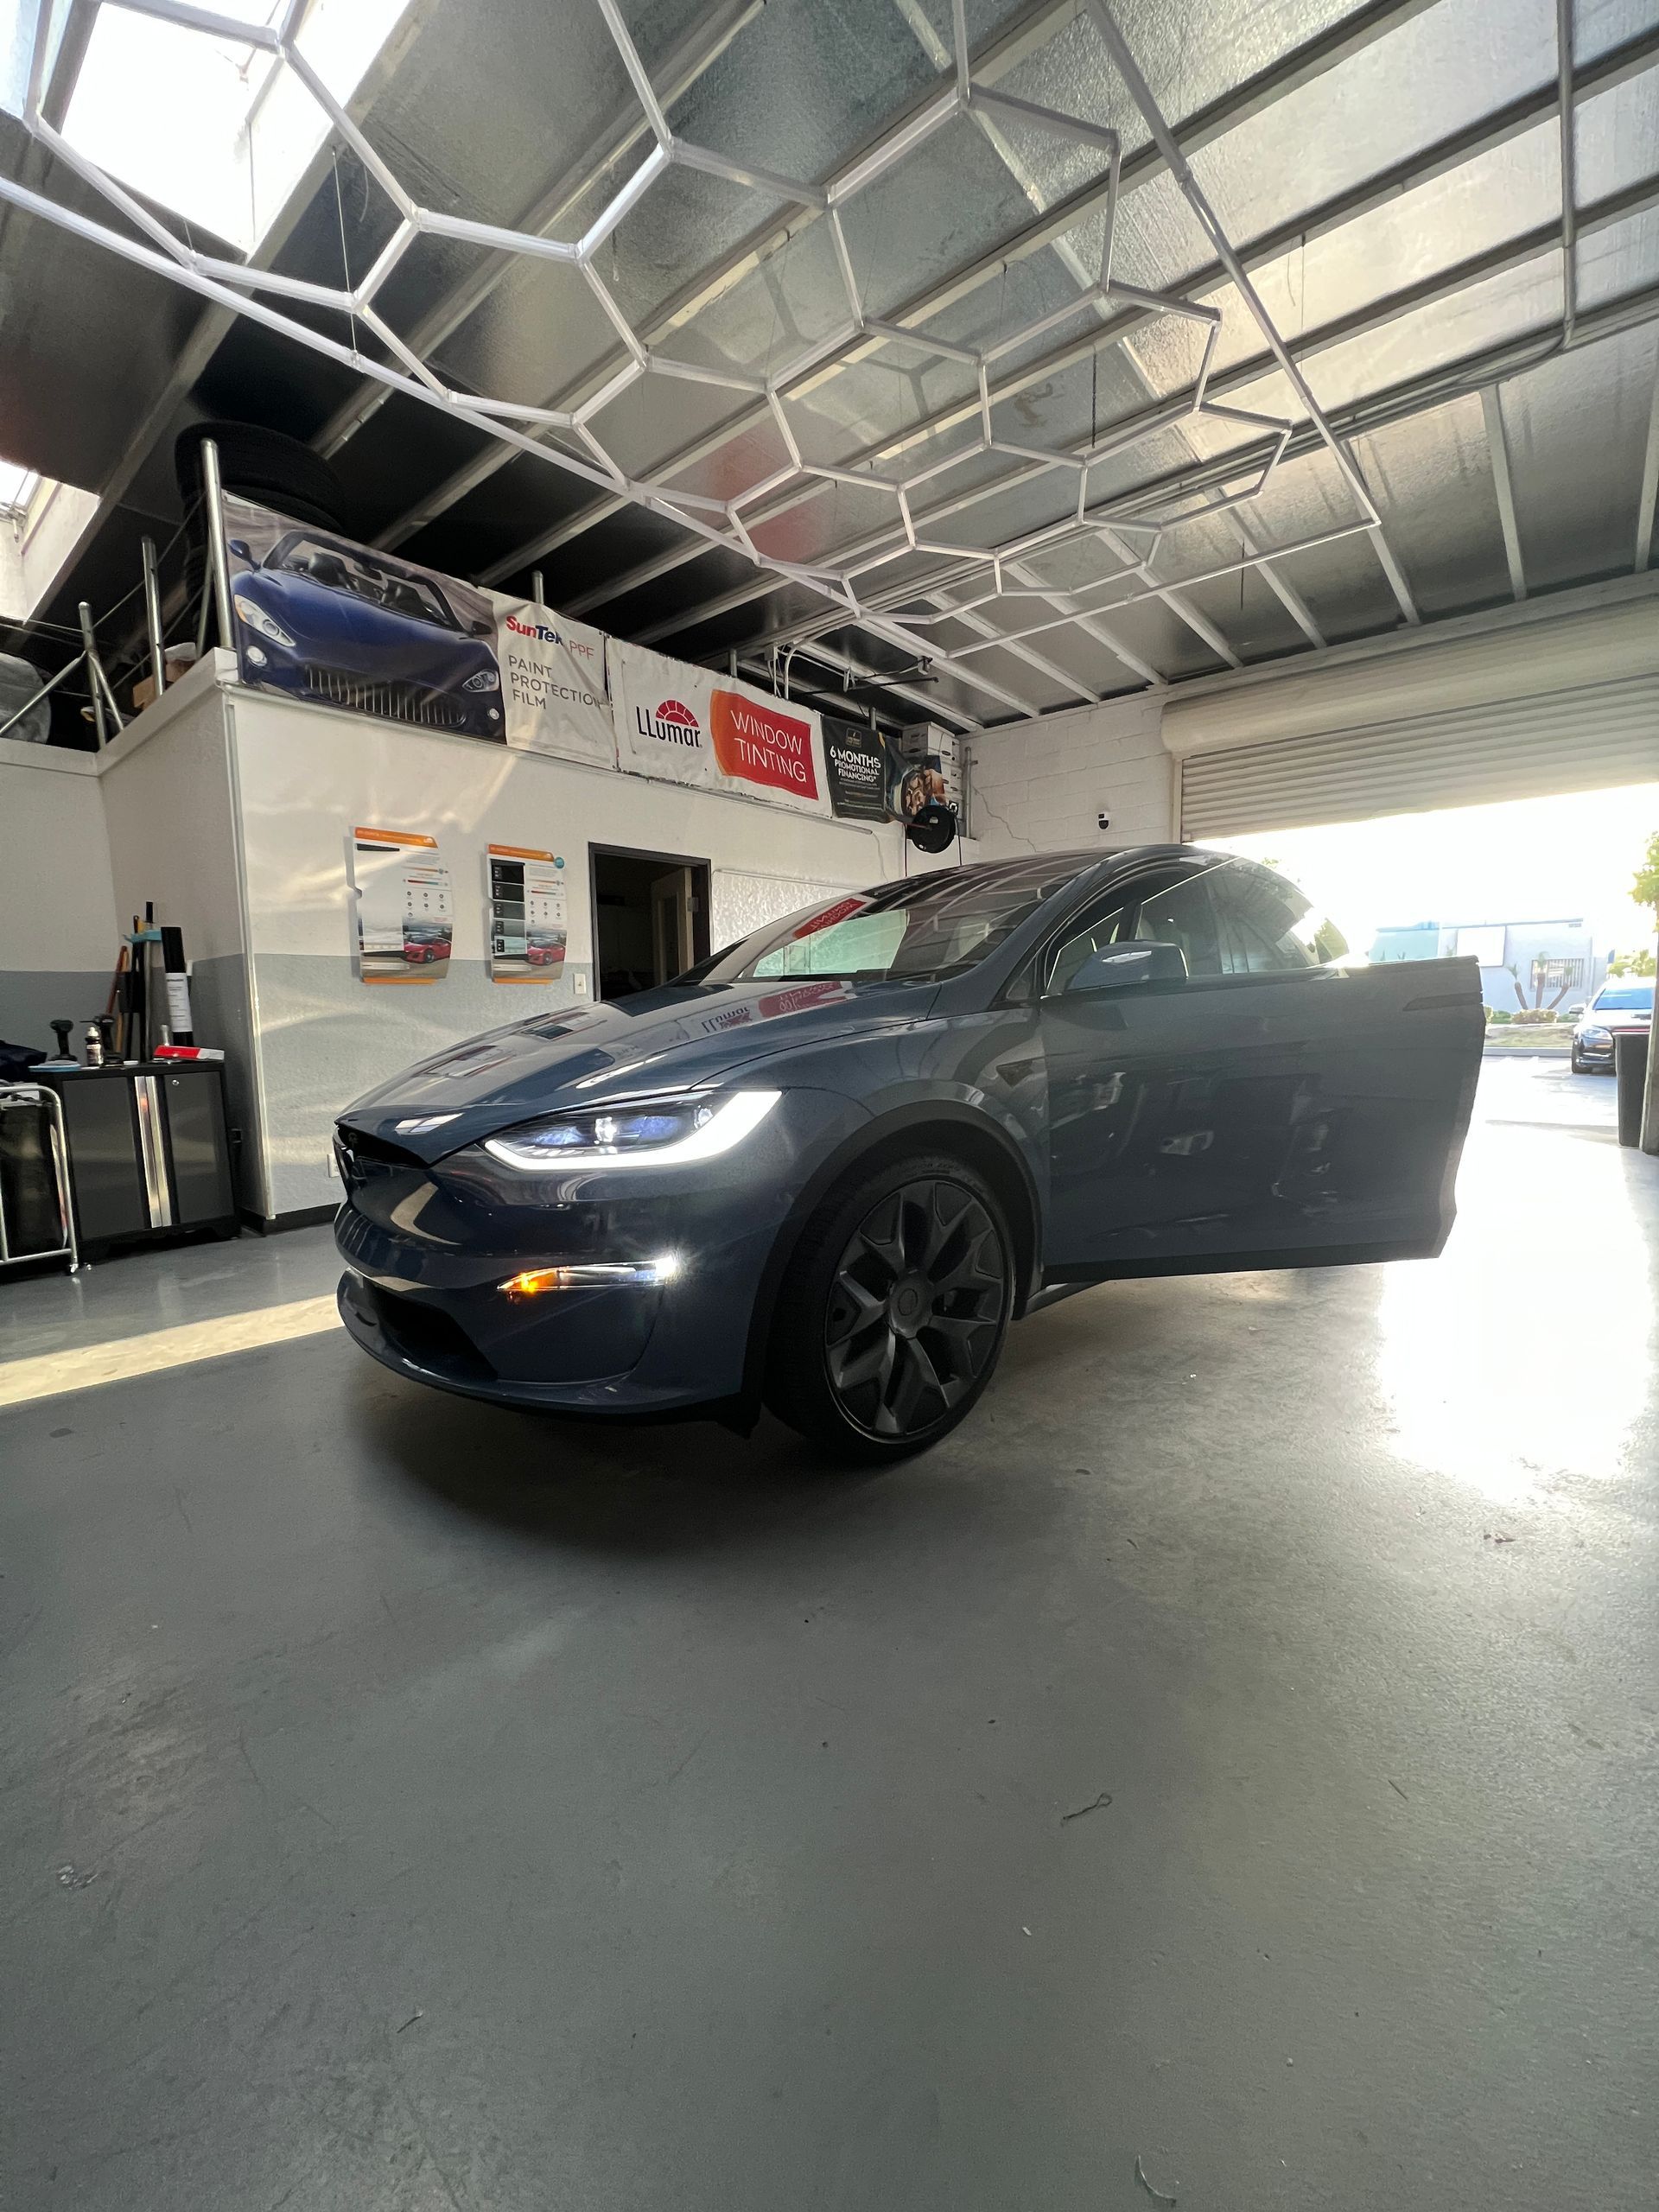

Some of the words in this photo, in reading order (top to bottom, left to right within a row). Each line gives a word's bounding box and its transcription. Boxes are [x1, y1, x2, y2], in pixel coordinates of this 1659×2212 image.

[505, 615, 563, 645] SunTek
[569, 640, 594, 660] PPF
[508, 655, 552, 678] PAINT
[513, 689, 547, 709] FILM
[636, 705, 702, 748] LLumar
[730, 709, 803, 755] WINDOW
[734, 737, 807, 783] TINTING
[830, 745, 836, 759] 6
[837, 749, 881, 768] MONTHS
[834, 759, 880, 776] PROMOTIONAL
